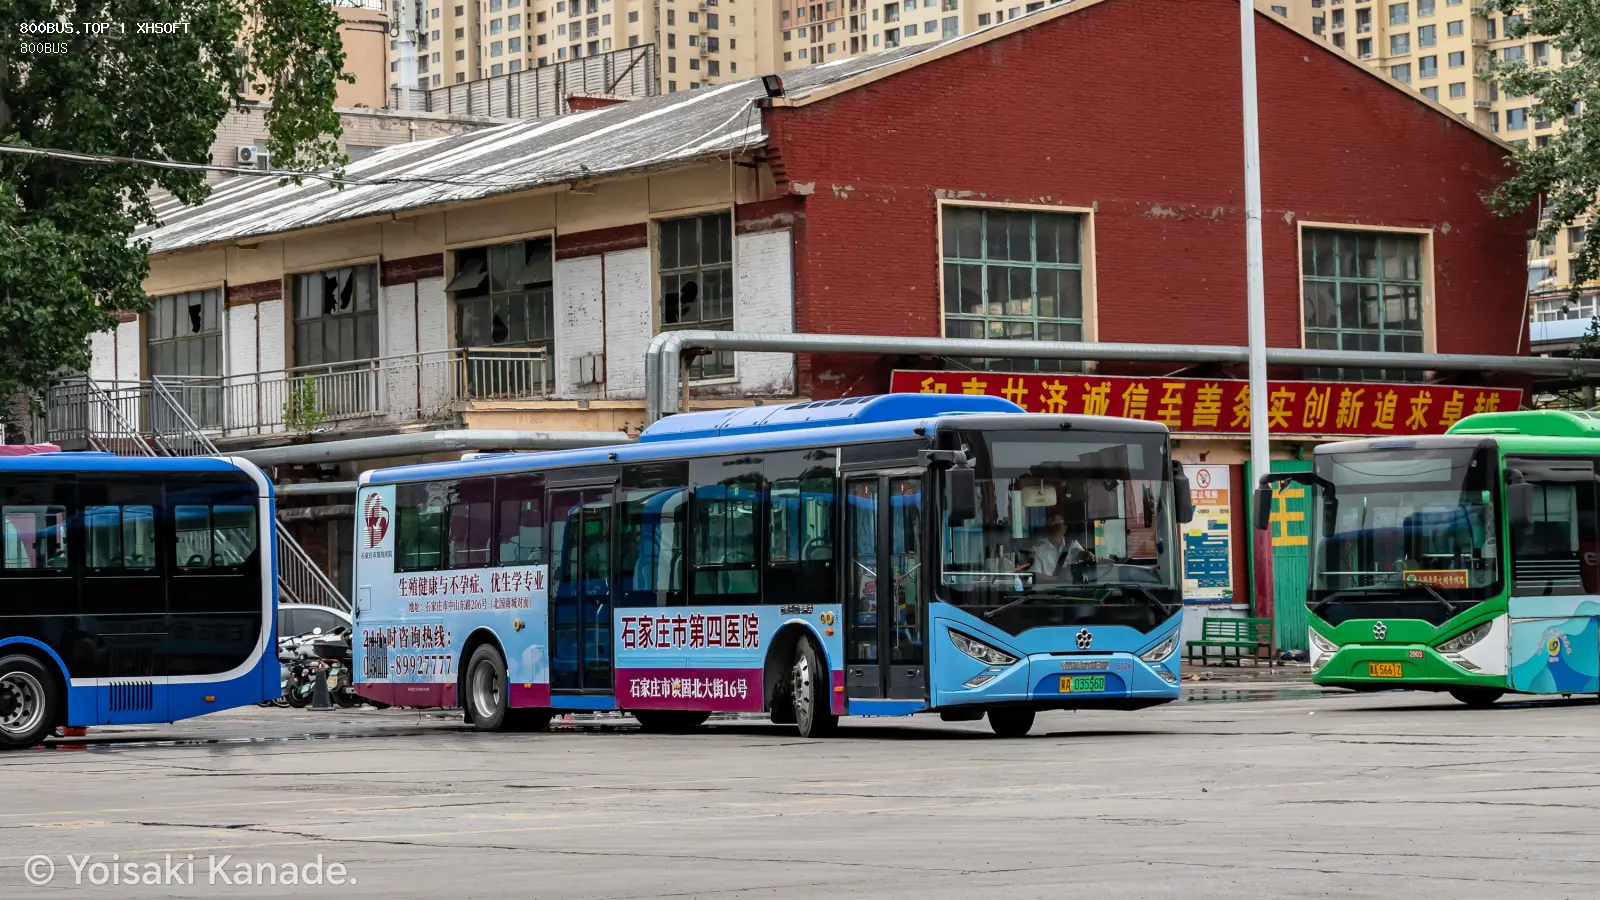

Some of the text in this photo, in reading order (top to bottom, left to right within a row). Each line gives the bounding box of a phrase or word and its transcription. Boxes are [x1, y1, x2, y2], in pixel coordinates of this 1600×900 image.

[398, 570, 545, 598] 生殖健康与不孕症、优生学专业
[621, 611, 760, 650] 石家庄市第四医院
[363, 654, 452, 677] 0311-89927777
